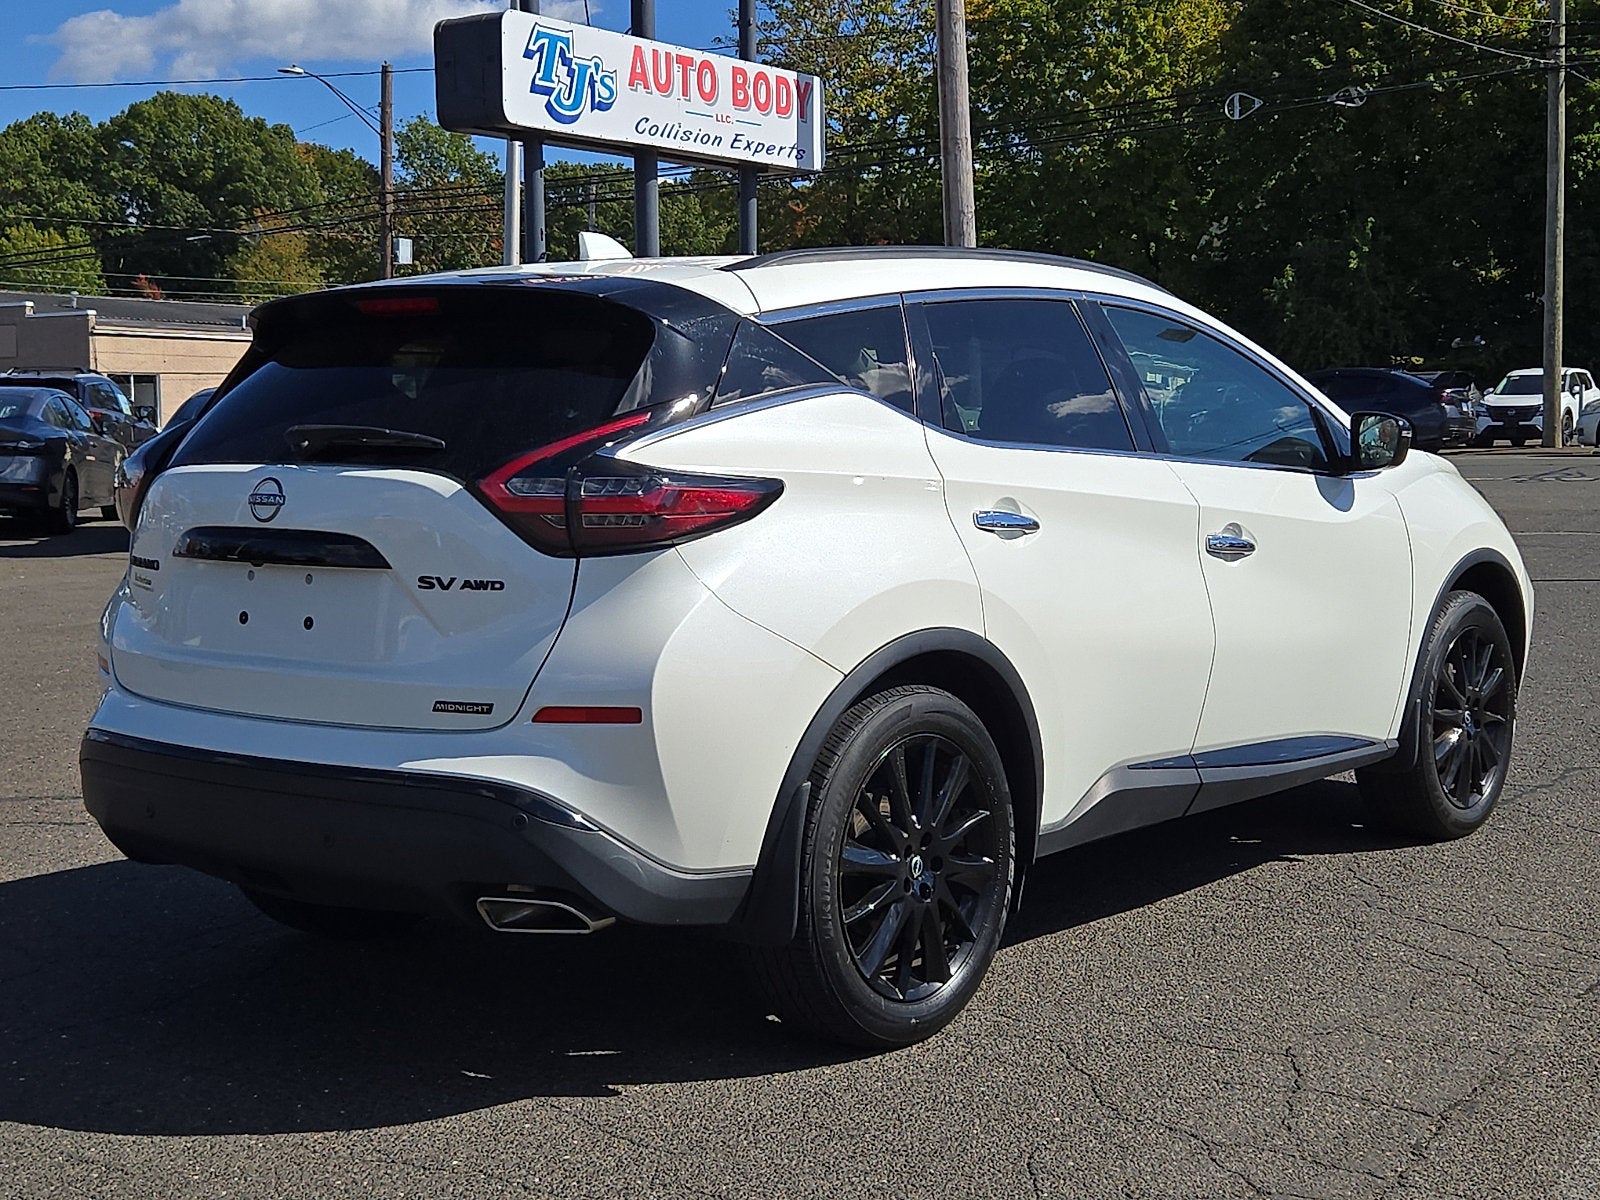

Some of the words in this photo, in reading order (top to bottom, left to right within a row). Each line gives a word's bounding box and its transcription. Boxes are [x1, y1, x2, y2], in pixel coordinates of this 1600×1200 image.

[523, 22, 618, 124] TJ's
[628, 45, 718, 106] AUTO
[731, 65, 812, 121] BODY
[715, 113, 734, 125] LLC.
[634, 117, 723, 148] Collision
[730, 135, 806, 161] Experts
[248, 494, 284, 505] NISSAN
[417, 575, 457, 591] SV
[459, 579, 505, 591] AWD
[435, 703, 490, 713] MIDNIGHT
